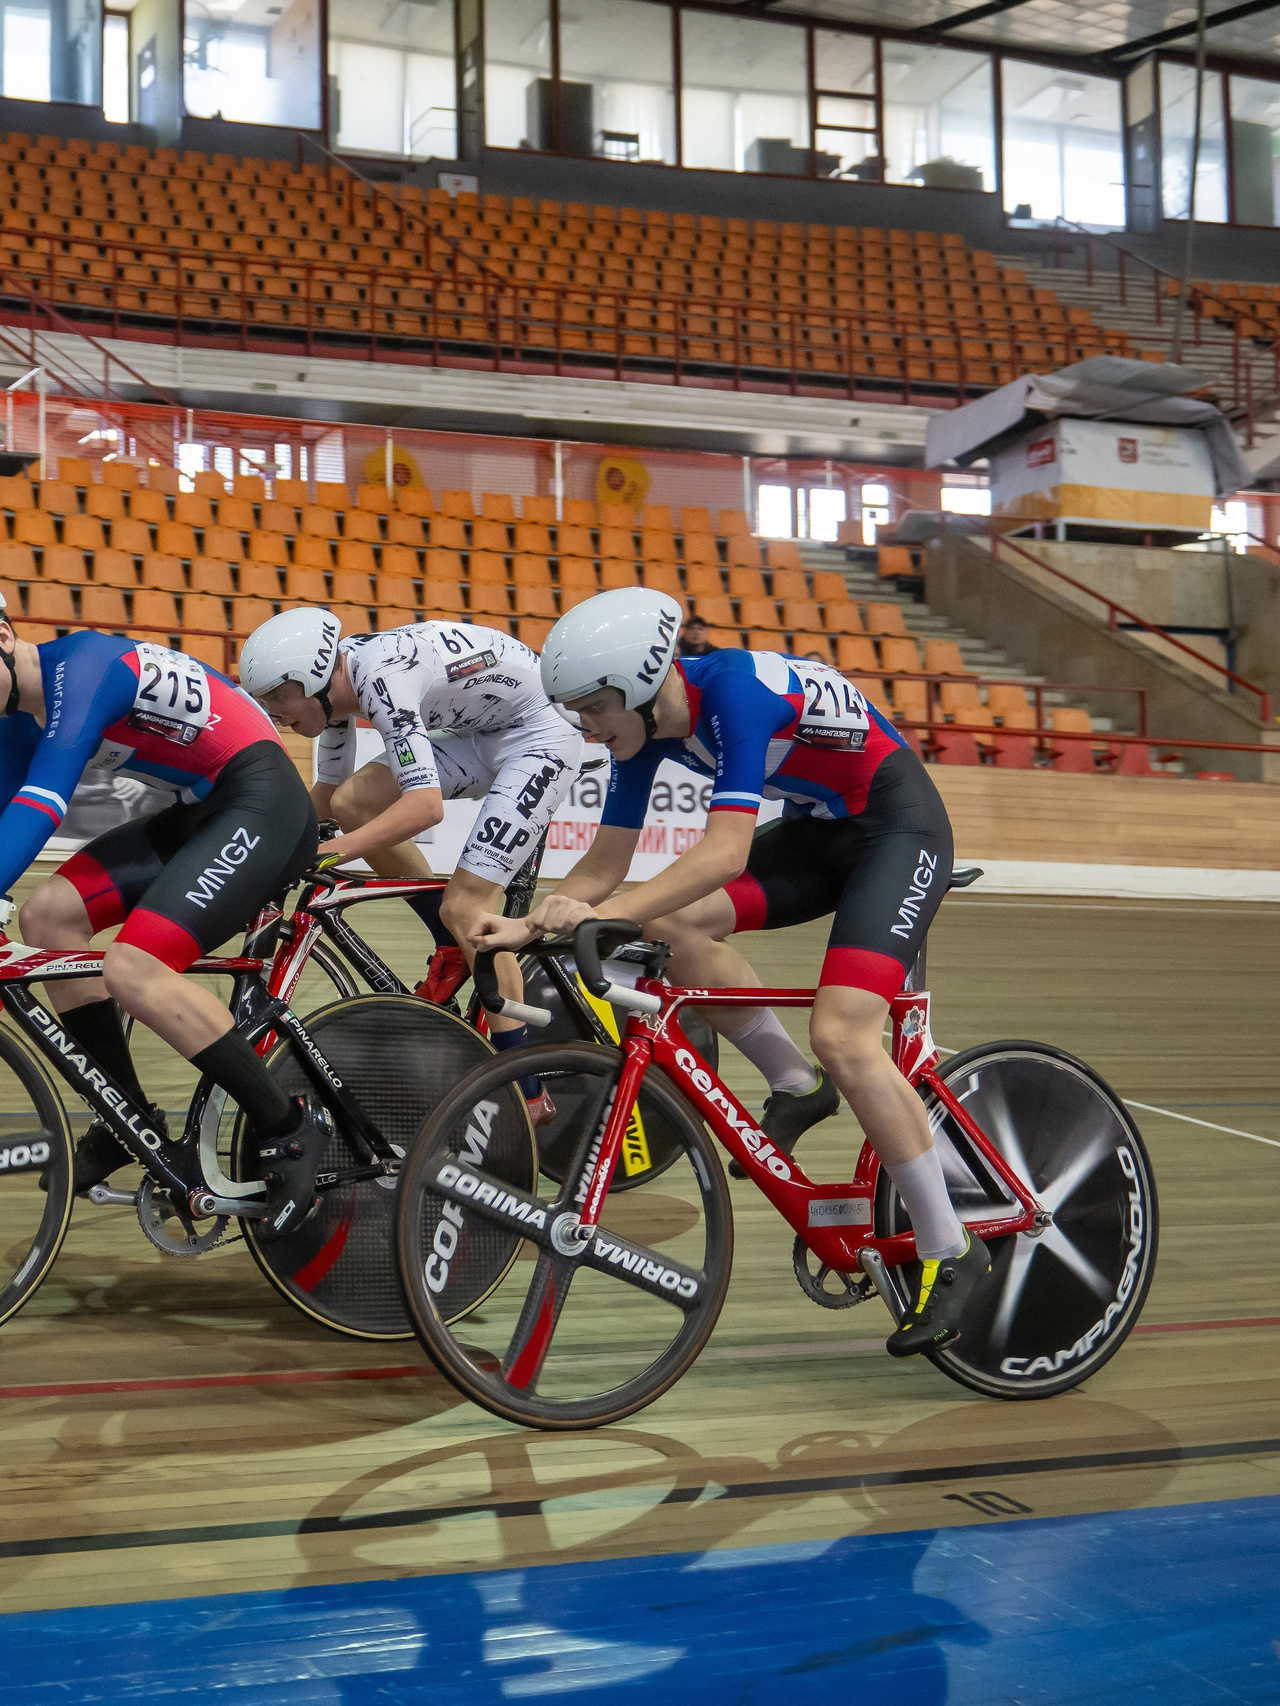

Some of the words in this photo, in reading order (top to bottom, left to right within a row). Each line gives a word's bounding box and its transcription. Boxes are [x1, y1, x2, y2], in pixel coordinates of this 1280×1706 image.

[310, 620, 336, 679] KASK
[439, 628, 475, 655] 61
[637, 609, 677, 685] KASK
[139, 662, 203, 714] 215
[805, 678, 862, 719] 214
[516, 765, 556, 820] KTM
[477, 816, 530, 854] SLP
[185, 827, 261, 909] MNGZ
[890, 849, 939, 940] MNGZ
[46, 961, 103, 972] PINARELL
[27, 1006, 162, 1151] PINARELLO
[289, 1018, 343, 1089] PINARELLO
[675, 1048, 791, 1181] cervélo
[436, 1164, 548, 1231] CORIMA
[593, 1237, 699, 1299] CORIMA
[999, 1145, 1146, 1375] CAMPAGNOLO
[941, 1490, 1033, 1517] 10
